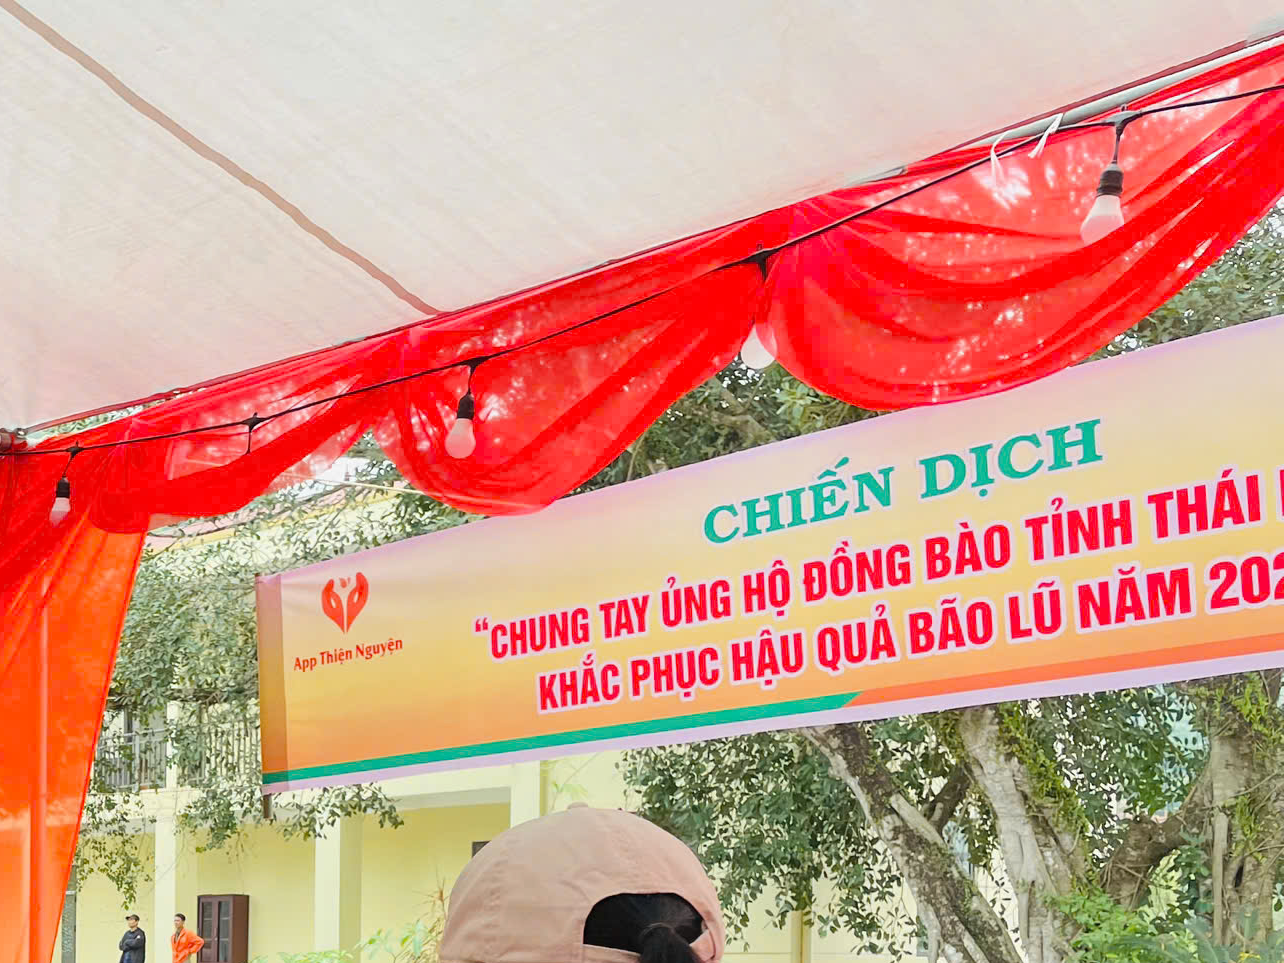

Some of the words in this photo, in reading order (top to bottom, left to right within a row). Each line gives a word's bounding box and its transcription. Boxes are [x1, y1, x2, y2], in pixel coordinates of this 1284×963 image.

[704, 456, 895, 543] CHIẾN
[919, 419, 1103, 498] DỊCH
[599, 595, 650, 638] TAY
[661, 576, 731, 627] ỦNG
[743, 559, 791, 616] HỘ
[803, 541, 911, 602] ĐỒNG
[925, 522, 1011, 580] BÀO
[1025, 497, 1133, 561] TỈNH
[1147, 468, 1261, 538] THÁI
[294, 657, 317, 672] App
[320, 647, 353, 664] Thiện
[355, 637, 403, 660] Nguyện
[539, 653, 620, 711] KHẮC
[631, 647, 720, 698] PHỤC
[731, 629, 804, 685] HẬU
[817, 604, 897, 671] QUẢ
[909, 597, 993, 654] BÃO
[1008, 580, 1062, 639] LŨ
[1077, 566, 1192, 629] NĂM
